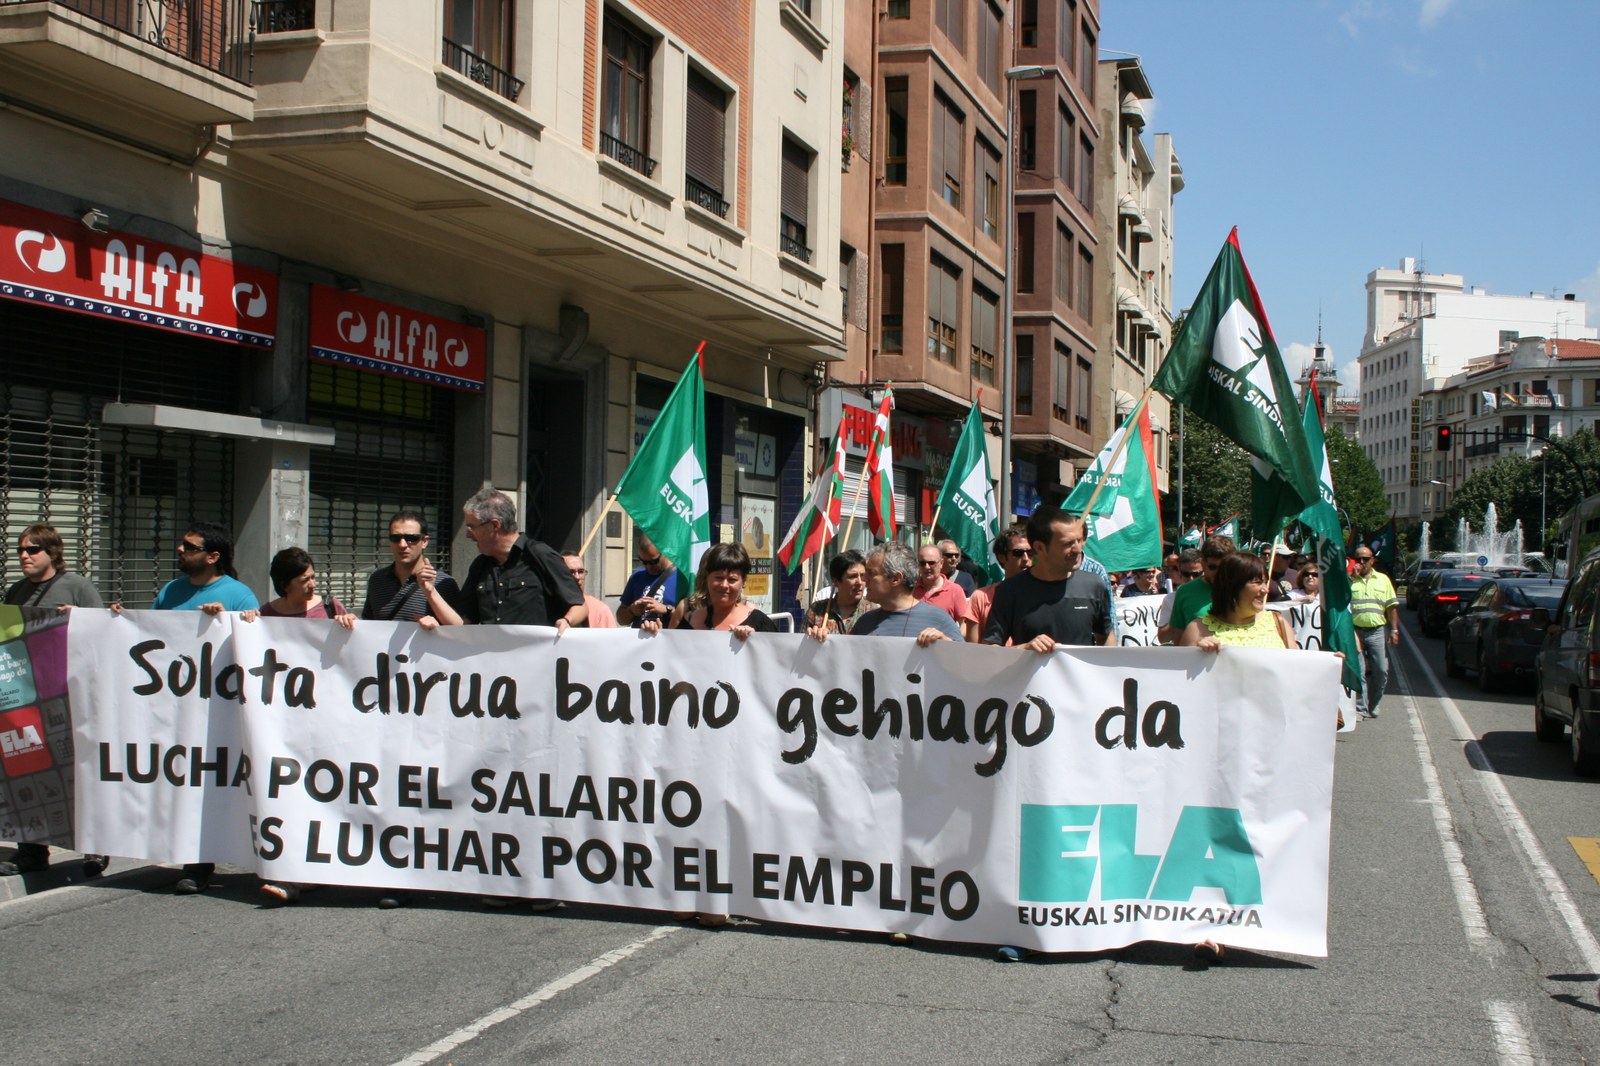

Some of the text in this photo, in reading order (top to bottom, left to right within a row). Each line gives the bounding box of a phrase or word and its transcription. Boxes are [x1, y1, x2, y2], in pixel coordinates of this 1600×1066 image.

[659, 482, 693, 527] EUSK
[352, 652, 522, 720] dirua
[555, 657, 741, 730] baino
[776, 668, 1055, 778] gehiago
[1094, 677, 1185, 750] da
[268, 756, 380, 806] POR
[397, 765, 453, 811] EL
[471, 768, 703, 828] SALARIO
[305, 820, 522, 879] LUCHAR
[542, 836, 654, 889] POR
[673, 846, 734, 894] EL
[752, 852, 980, 922] EMPLEO
[1018, 803, 1264, 905] ELA
[1018, 903, 1263, 929] EUSKAL SINDIKATUA
